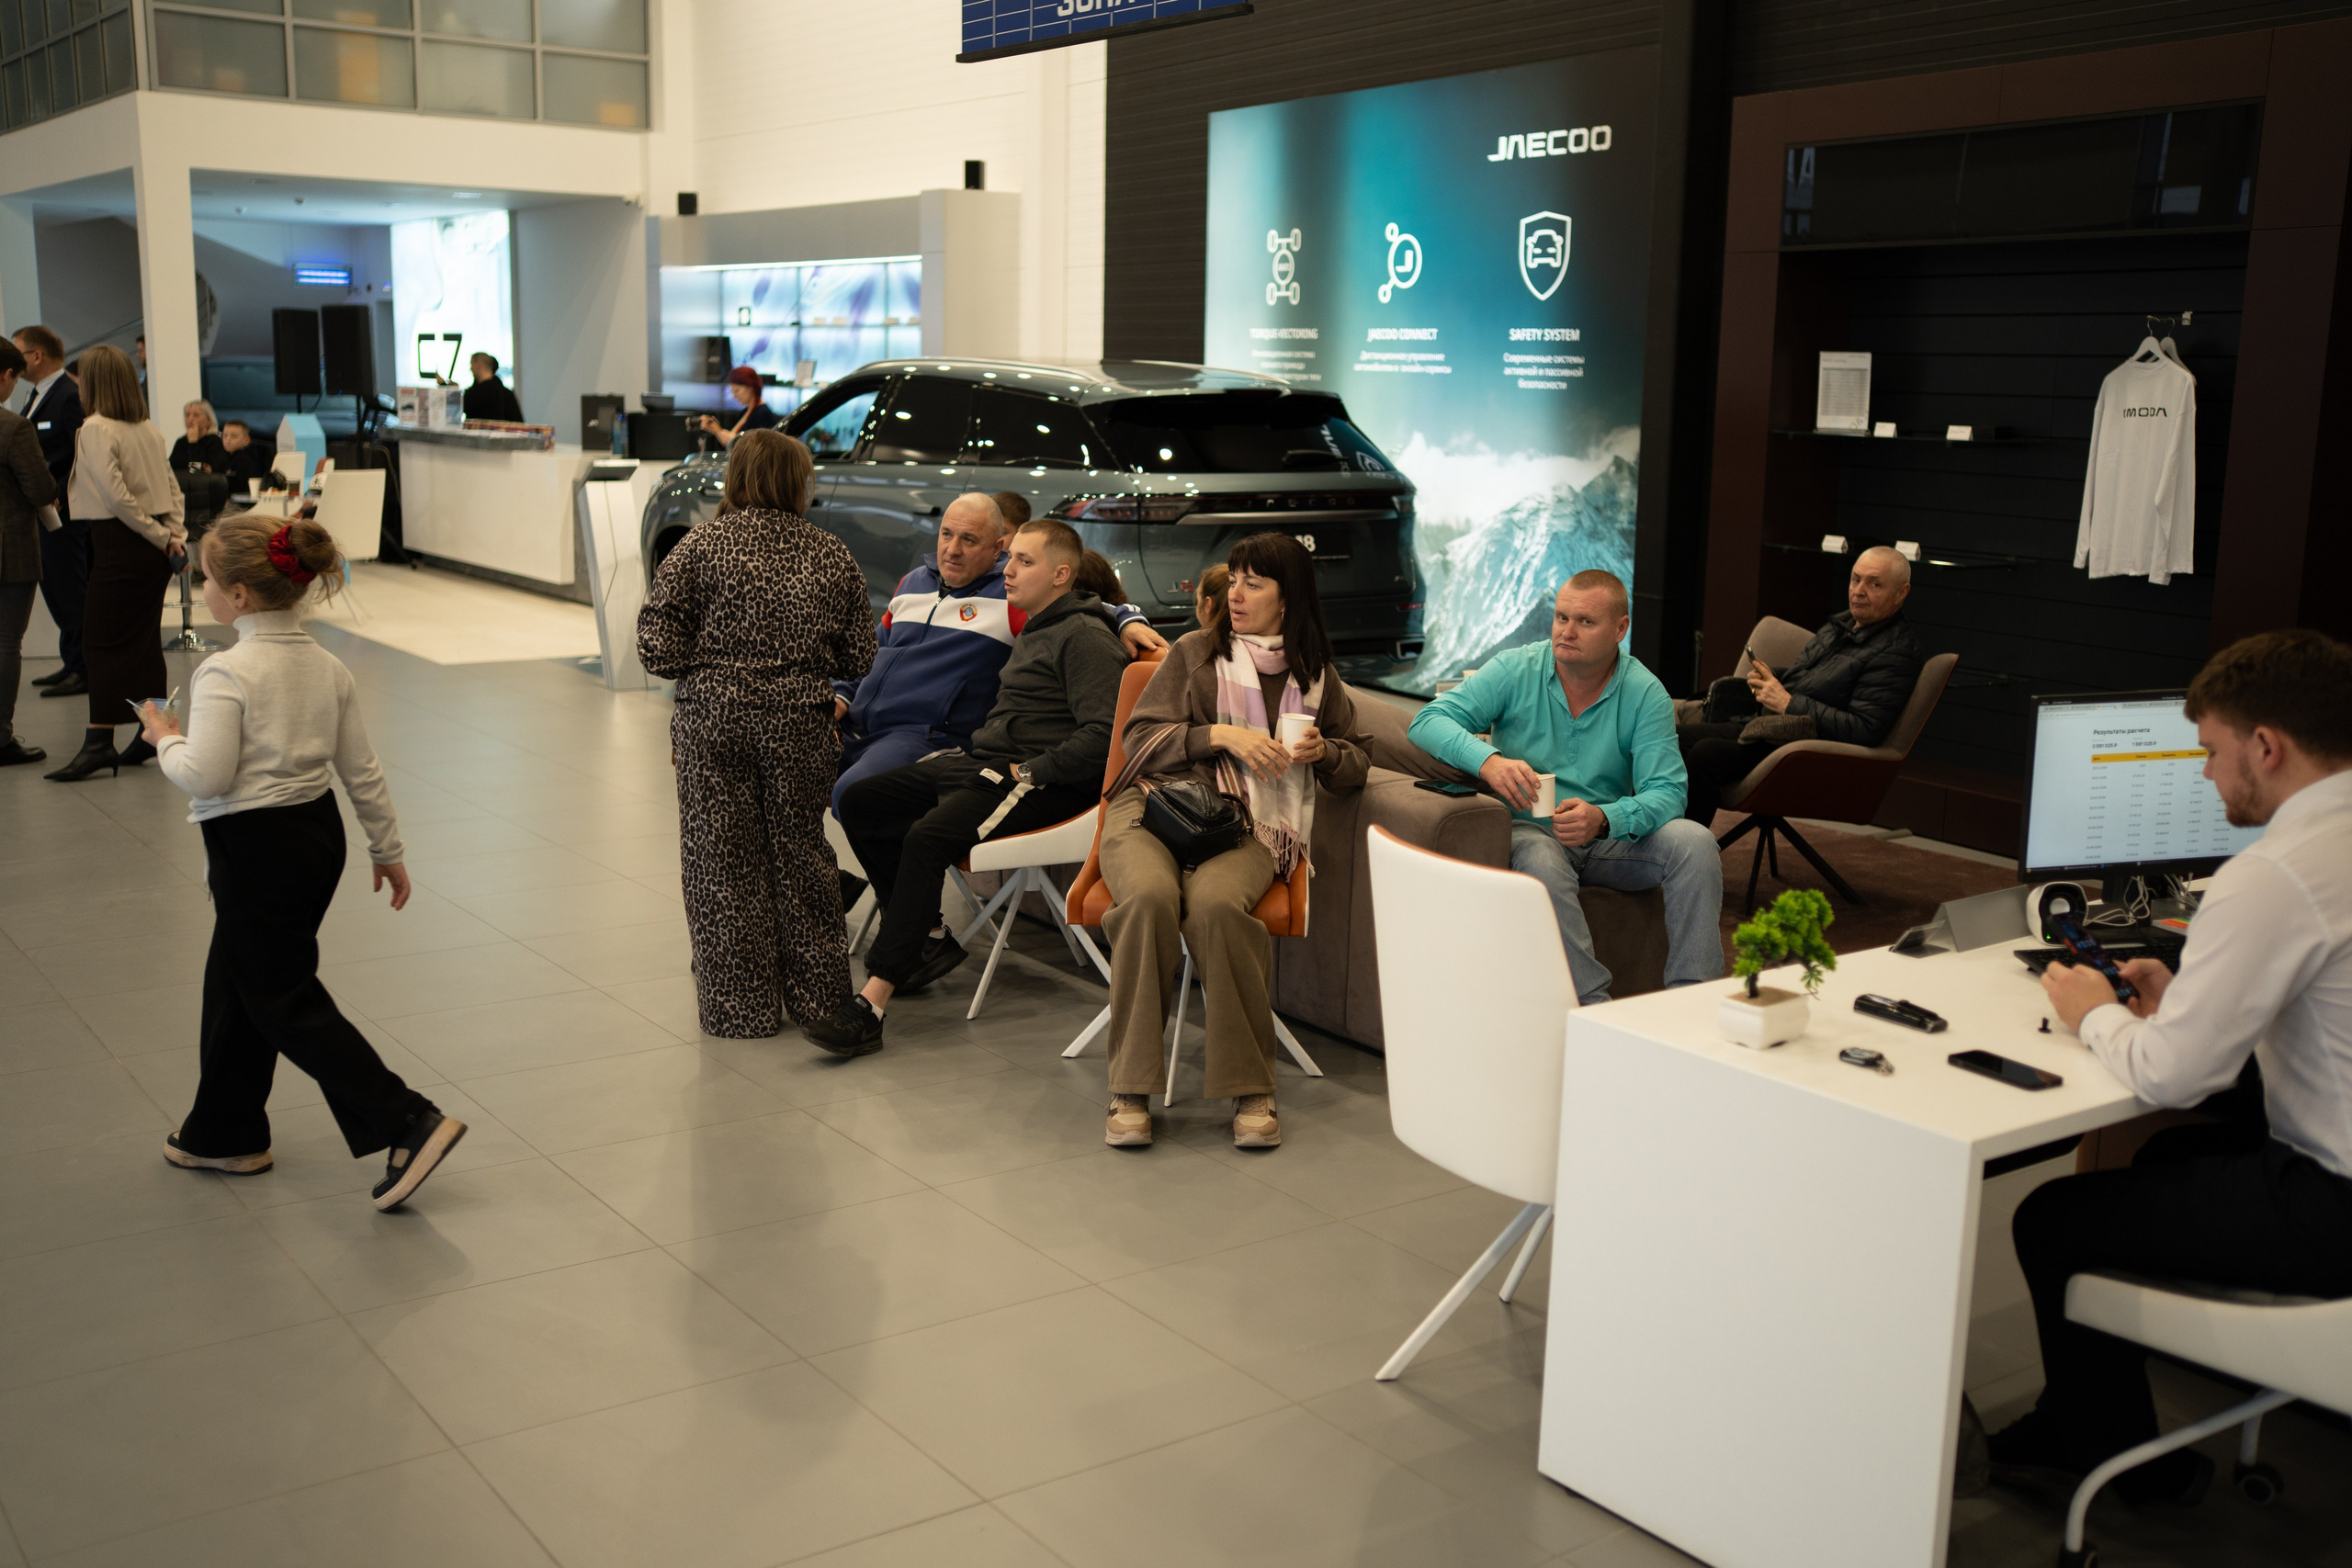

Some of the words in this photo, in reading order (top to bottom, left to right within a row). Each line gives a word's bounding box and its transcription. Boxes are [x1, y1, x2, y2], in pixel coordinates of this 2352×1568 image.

[1057, 0, 1136, 17] ЗО
[1487, 125, 1611, 162] JAECOO
[1398, 328, 1438, 340] CONNECT
[1510, 328, 1543, 341] SAFETY
[1544, 328, 1580, 341] SYSTEM
[1503, 352, 1553, 365] Современные
[1553, 355, 1585, 365] системы
